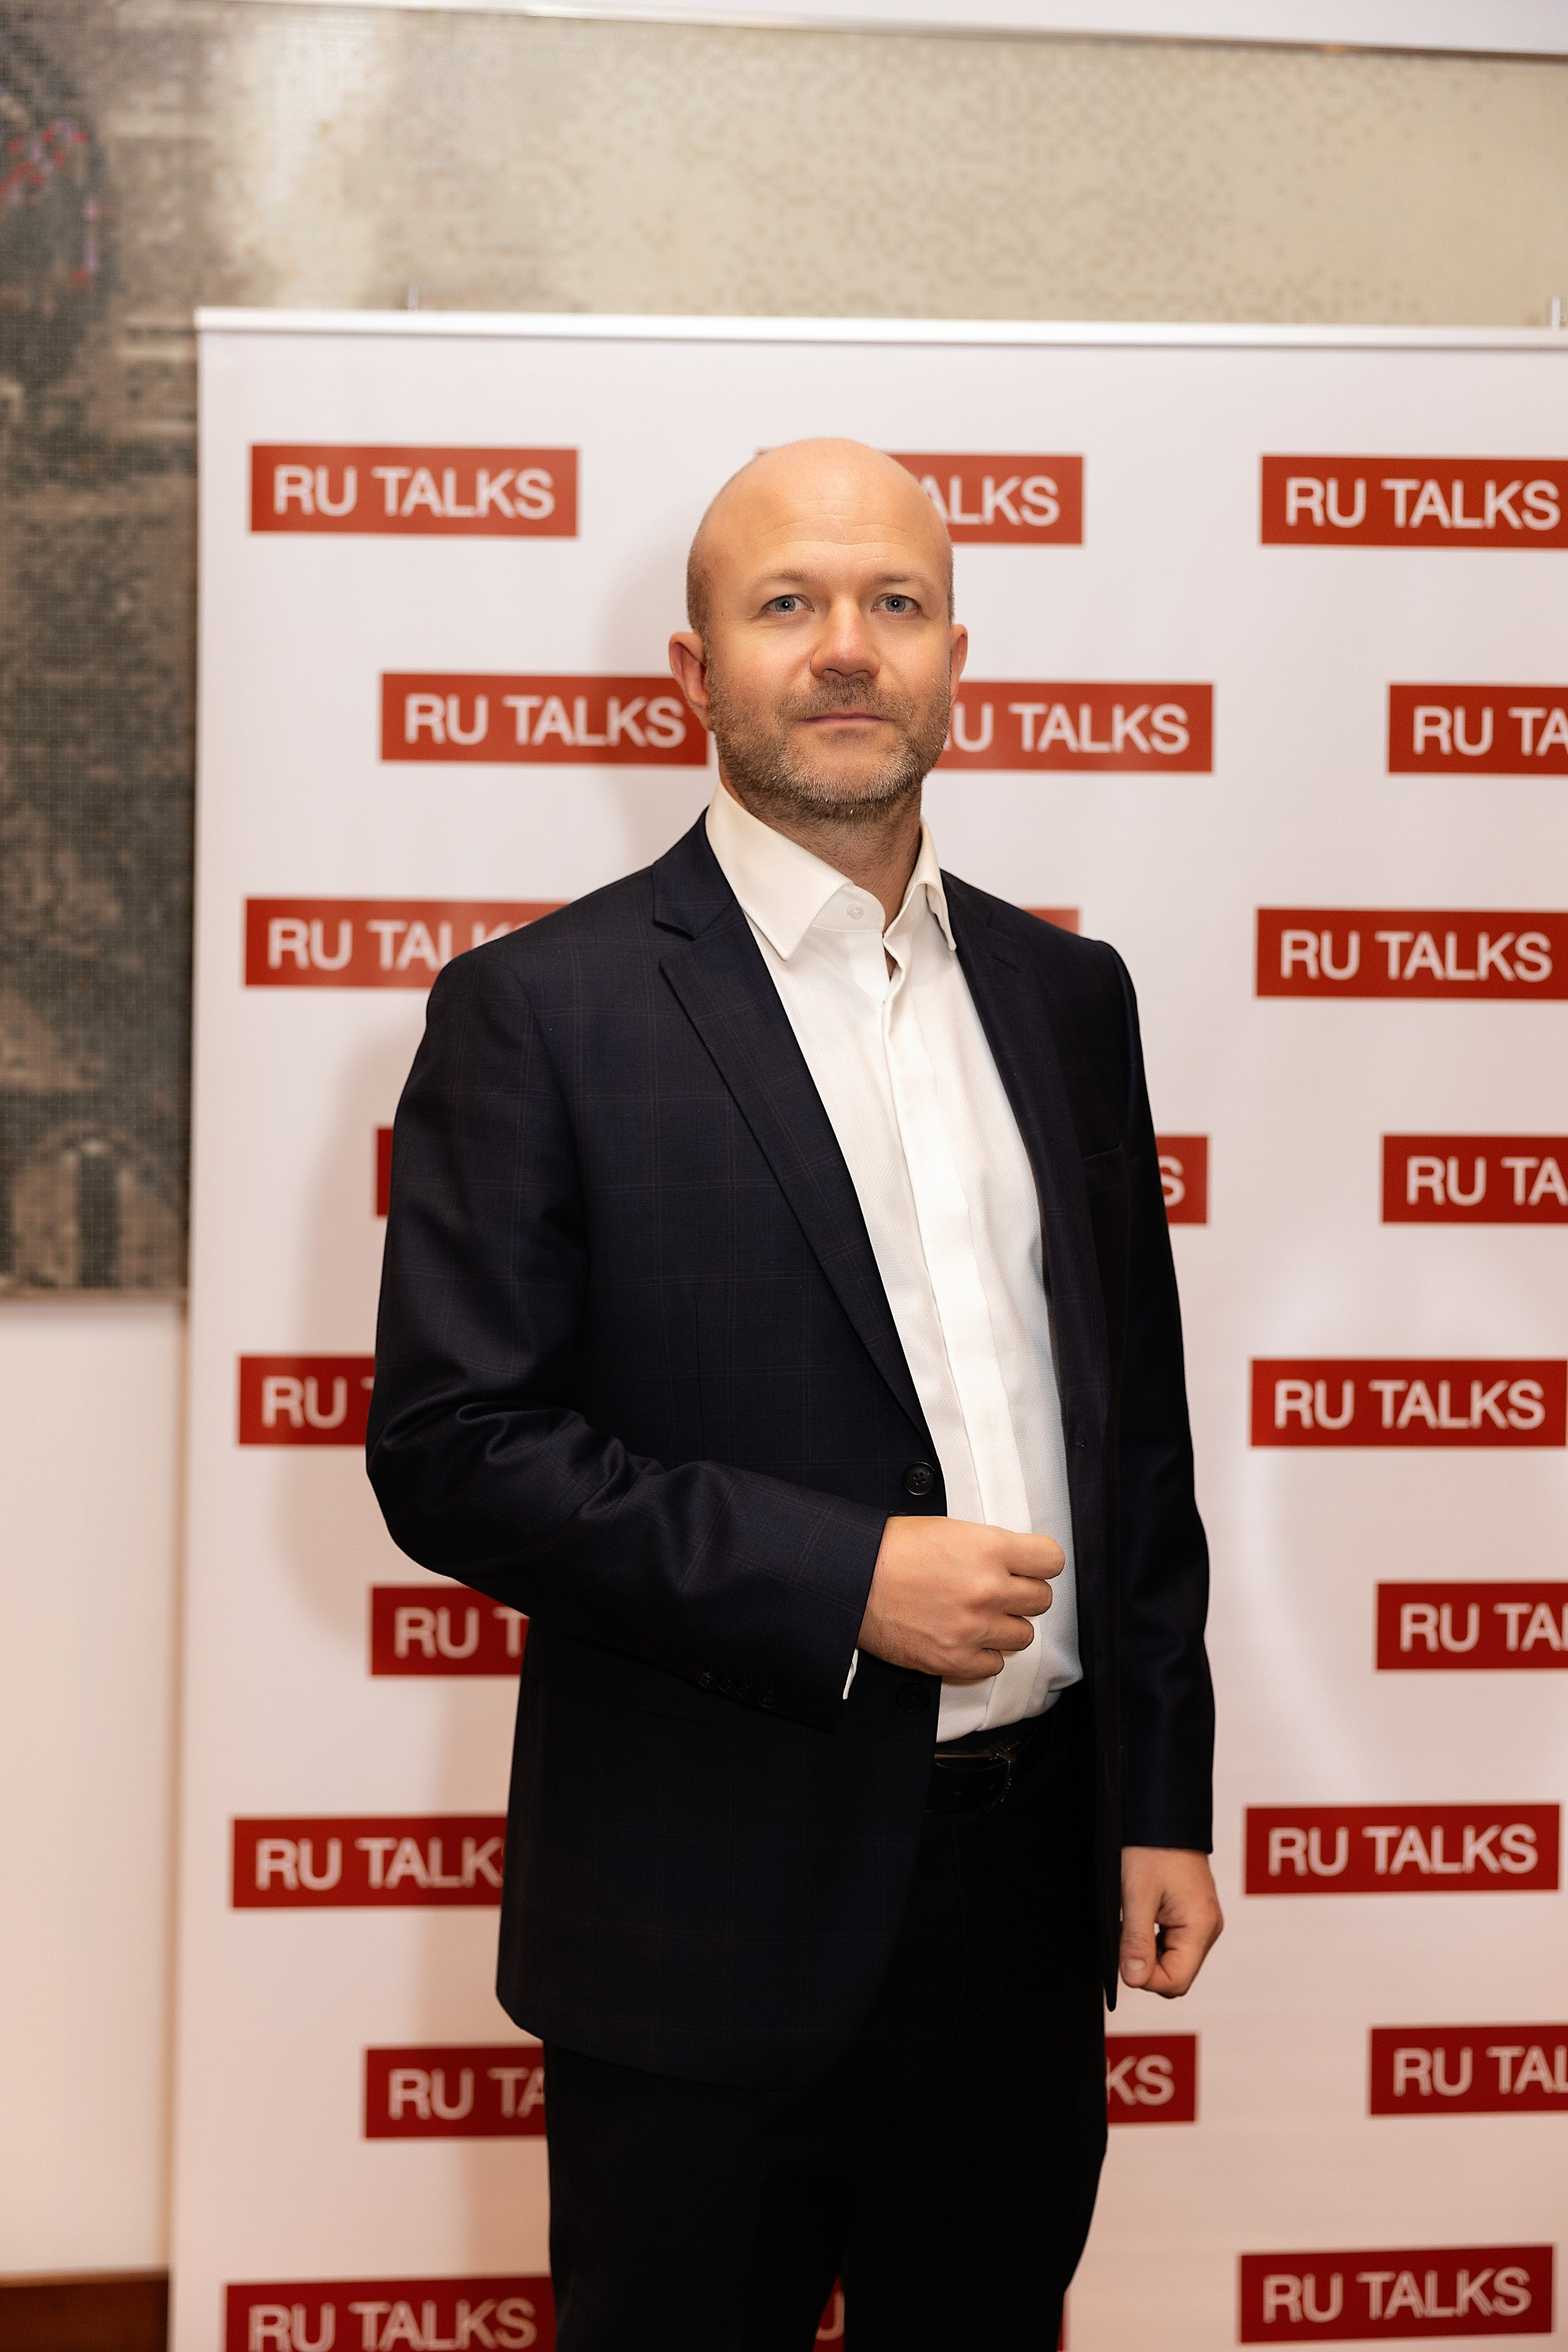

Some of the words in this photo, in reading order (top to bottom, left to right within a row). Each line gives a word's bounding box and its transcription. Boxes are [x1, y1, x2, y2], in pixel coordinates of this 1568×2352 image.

[274, 465, 358, 516] RU
[372, 467, 554, 519] TALKS
[920, 475, 1060, 527] ALKS
[1286, 477, 1366, 527] RU
[1382, 479, 1560, 530] TALKS
[405, 693, 488, 745] RU
[502, 695, 687, 747] TALKS
[944, 703, 993, 753] U
[1008, 703, 1189, 754] TALKS
[1413, 706, 1493, 756] RU
[268, 918, 353, 971] RU
[1281, 930, 1360, 980] RU
[1375, 931, 1552, 982] TALKS
[1407, 1156, 1486, 1205] RU
[262, 1376, 347, 1428] RU
[1275, 1379, 1354, 1429] RU
[1370, 1380, 1545, 1429] TALKS
[395, 1607, 478, 1658] RU
[1400, 1604, 1479, 1652] RU
[256, 1839, 342, 1890] RU
[356, 1836, 503, 1888] TALK
[1269, 1827, 1348, 1876] RU
[1363, 1824, 1537, 1874] TALKS
[389, 2068, 472, 2119] RU
[1393, 2048, 1472, 2096] RU
[1263, 2274, 1343, 2323] RU
[1357, 2267, 1531, 2319] TALKS
[249, 2305, 335, 2352] RU
[349, 2298, 537, 2351] TALKS
